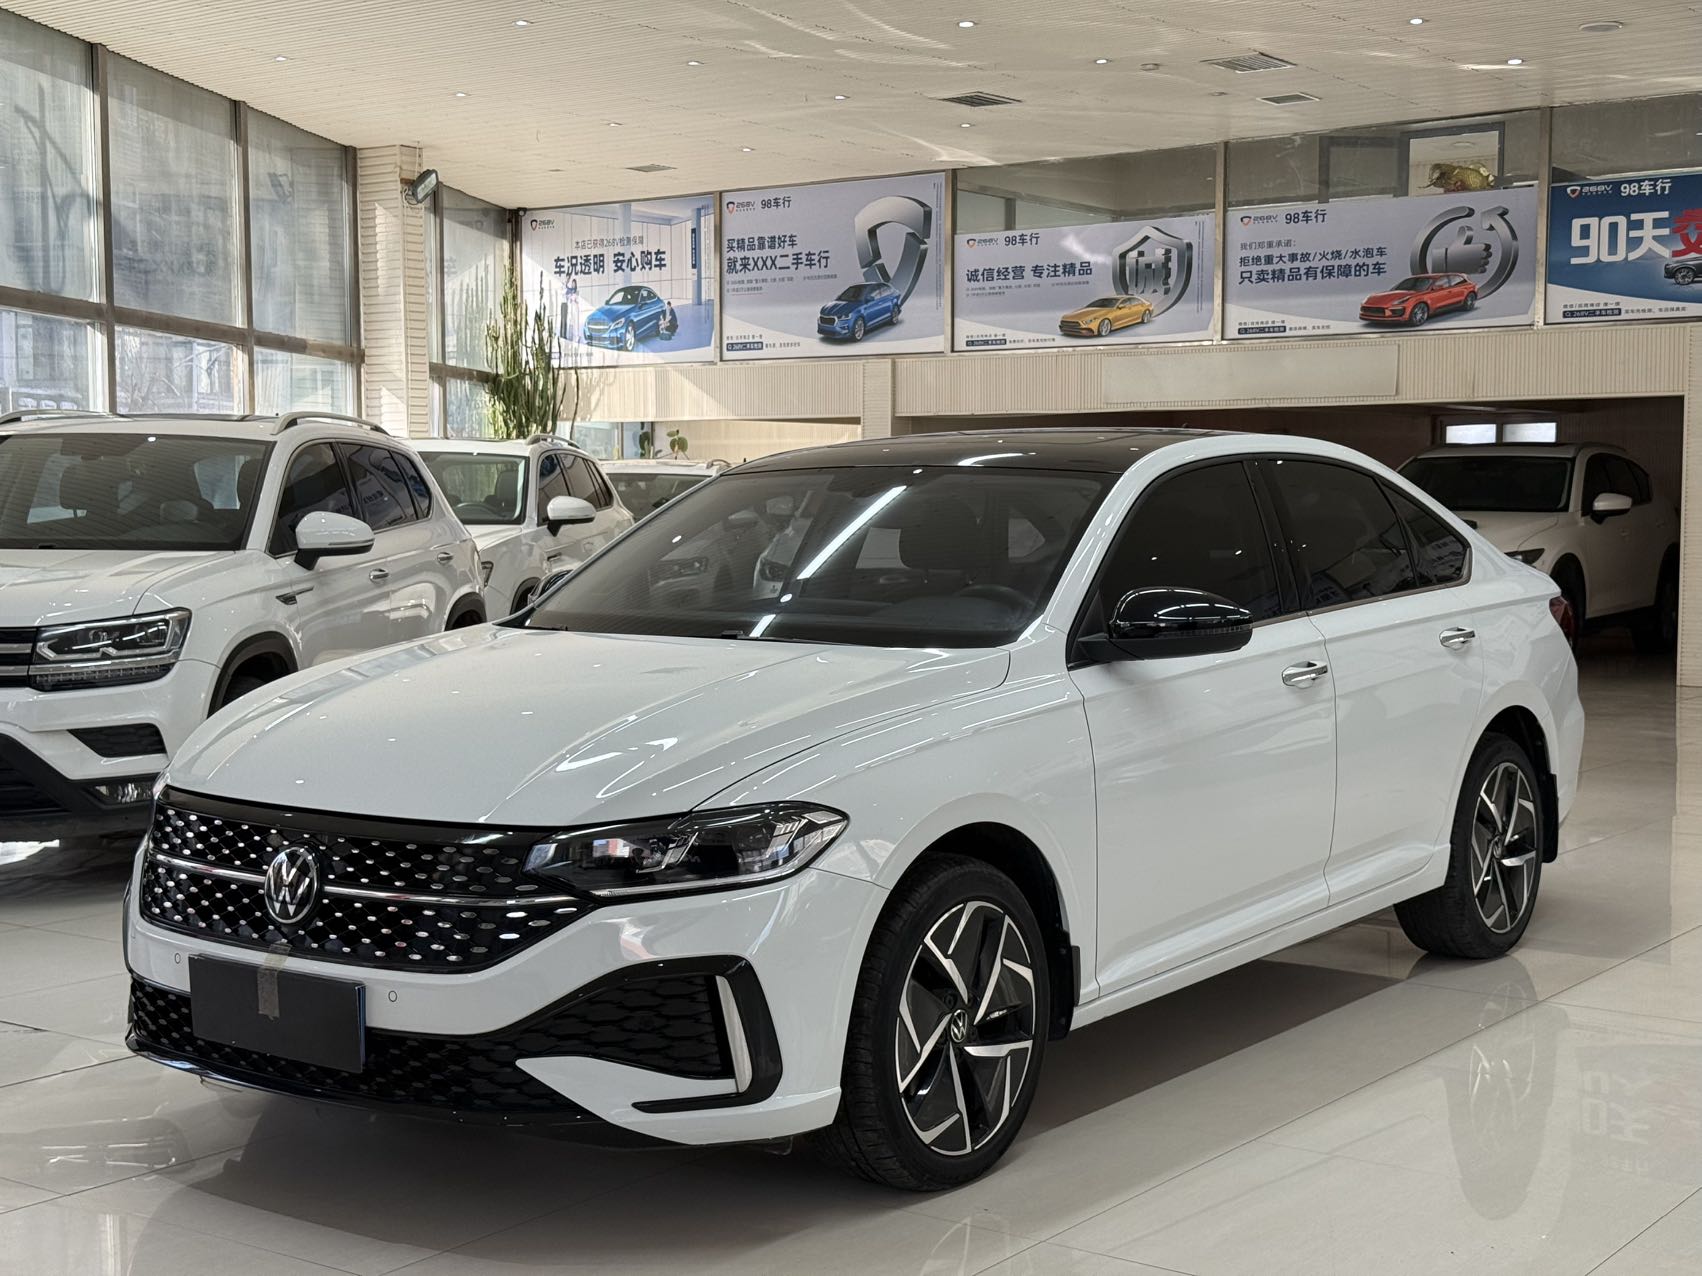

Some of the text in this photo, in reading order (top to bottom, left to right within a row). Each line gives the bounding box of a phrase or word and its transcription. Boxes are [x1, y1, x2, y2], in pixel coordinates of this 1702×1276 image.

[1620, 179, 1672, 196] 98车行
[761, 196, 791, 209] 98车行
[1285, 209, 1327, 224] 98车行
[726, 234, 798, 253] 买精品靠谱好车
[1004, 233, 1040, 246] 98车行
[554, 249, 667, 277] 车况透明 安心购车
[726, 250, 830, 275] 就来XXX二手车行
[1239, 246, 1388, 267] 拒绝重大事故/火烧/水泡车
[965, 261, 1093, 283] 诚信经营 专注精品
[1239, 261, 1387, 285] 只卖精品有保障的车
